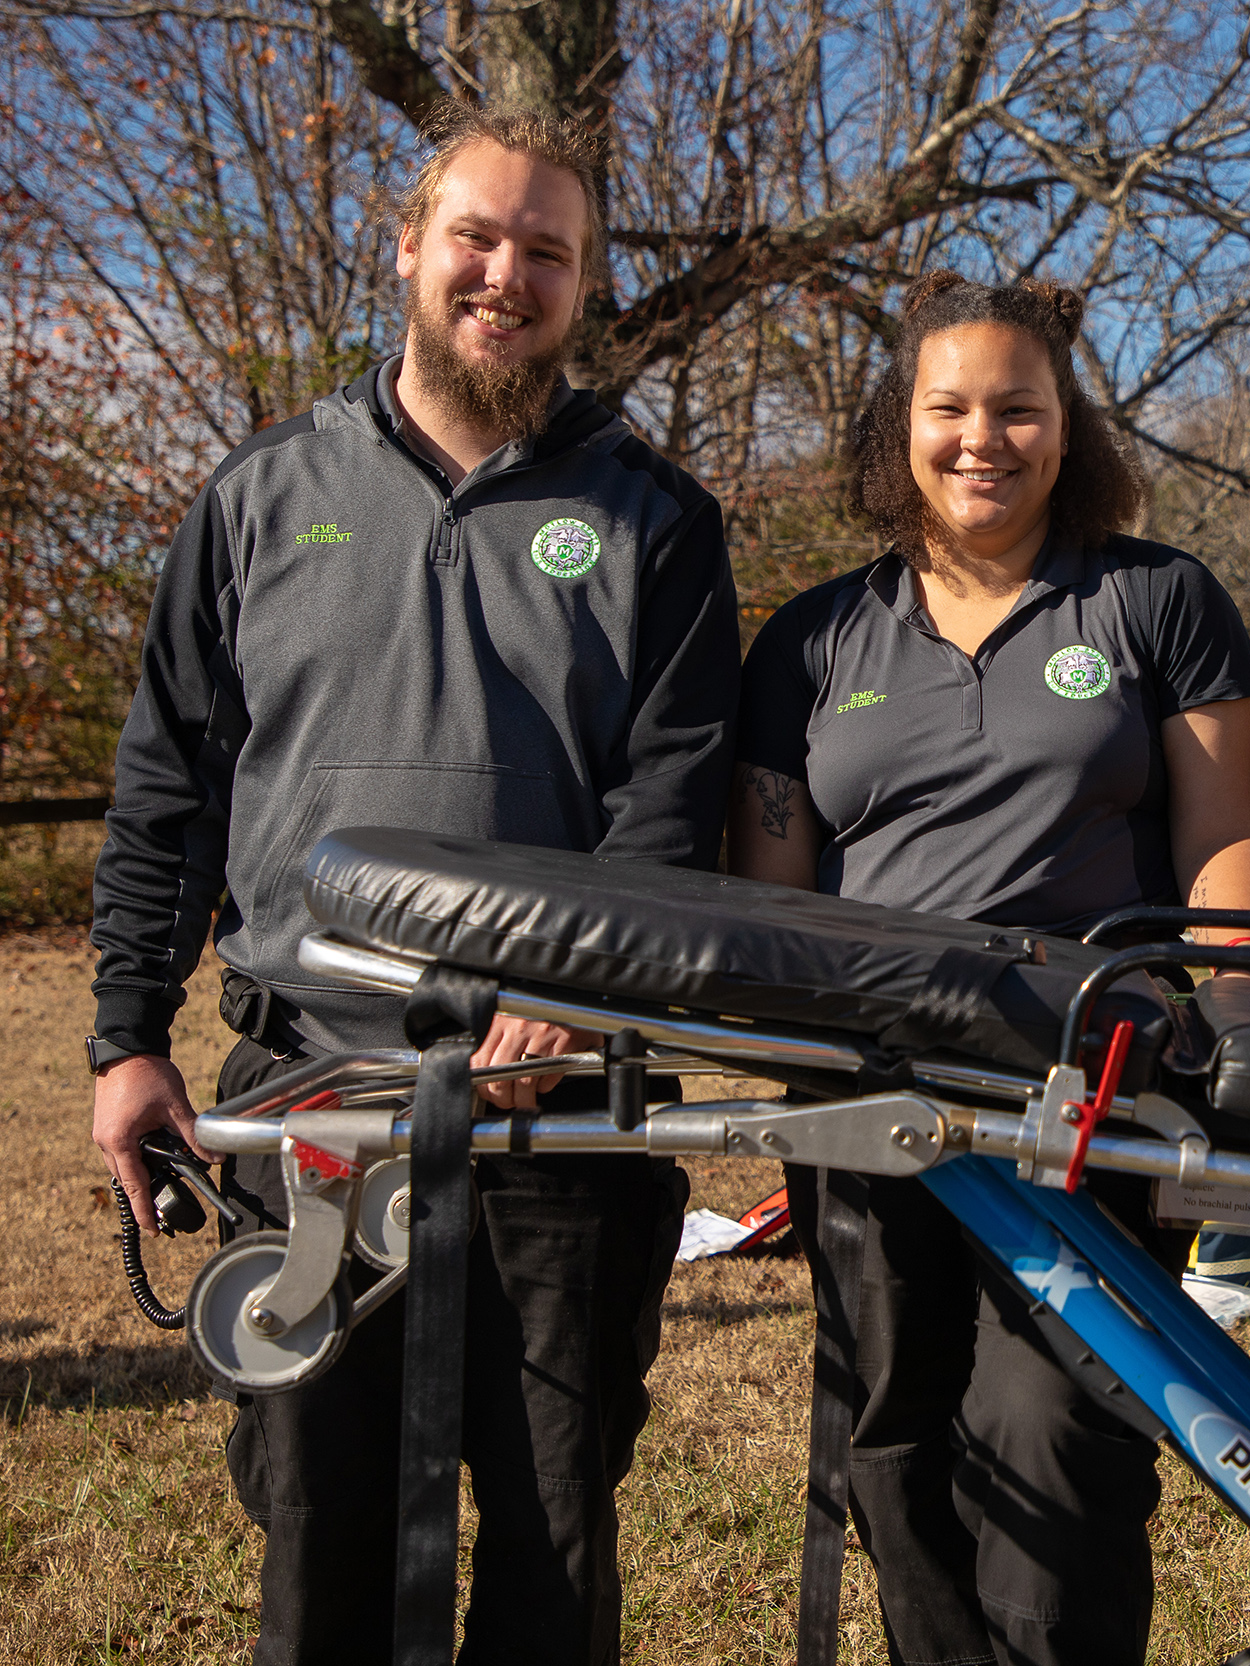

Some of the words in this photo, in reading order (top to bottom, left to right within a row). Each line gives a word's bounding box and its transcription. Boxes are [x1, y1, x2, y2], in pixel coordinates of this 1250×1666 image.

[311, 523, 337, 533] EMS
[295, 532, 353, 544] STUDENT
[559, 546, 571, 556] M
[1072, 672, 1084, 681] M
[850, 690, 875, 701] EMS
[836, 694, 887, 714] STUDENT
[1183, 1197, 1197, 1206] No
[1199, 1198, 1232, 1210] brachial
